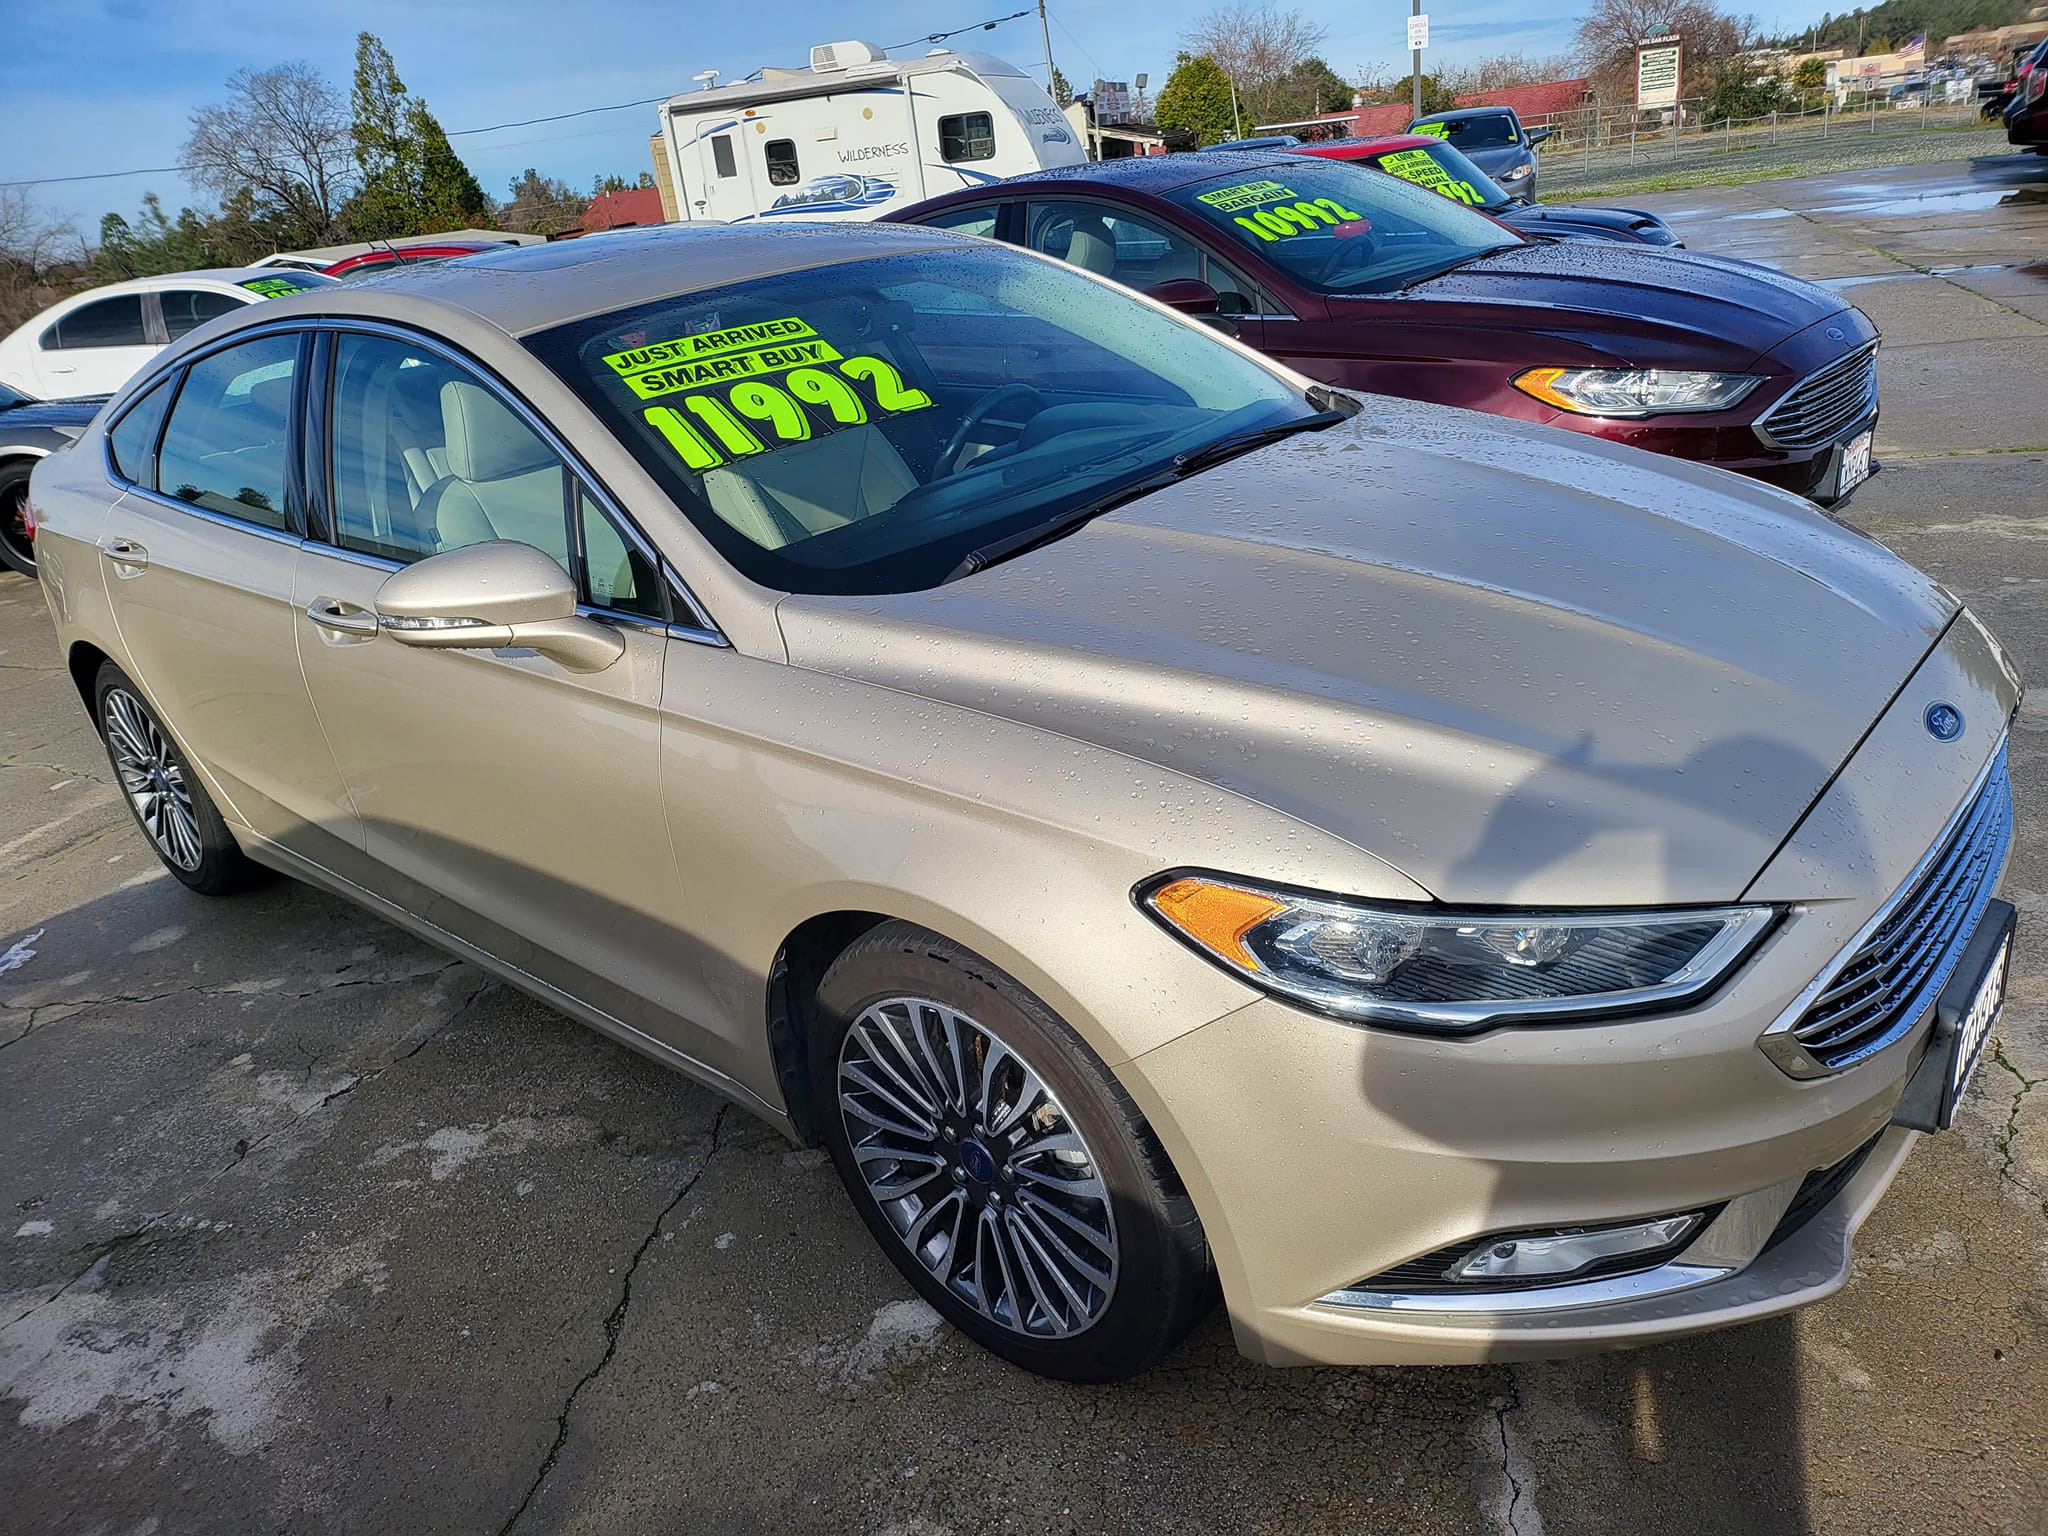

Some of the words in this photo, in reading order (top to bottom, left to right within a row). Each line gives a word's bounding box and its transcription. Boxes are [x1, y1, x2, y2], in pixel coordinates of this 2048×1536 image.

[837, 142, 909, 163] WILDERNESS
[1393, 151, 1415, 161] LOOK
[1390, 165, 1406, 174] JUST
[1407, 160, 1433, 169] ARRIVED
[1400, 167, 1441, 179] -SPEED
[1204, 186, 1244, 202] SMART
[1244, 181, 1271, 192] BUY
[1420, 175, 1448, 187] NUAL
[1217, 189, 1290, 211] BARGAIN
[1233, 198, 1363, 242] 10992
[617, 342, 684, 369] JUST
[693, 320, 805, 352] ARRIVED
[641, 356, 752, 391] SMART
[758, 344, 822, 367] BUY
[643, 356, 932, 470] 11992
[1931, 708, 1957, 735] Ford
